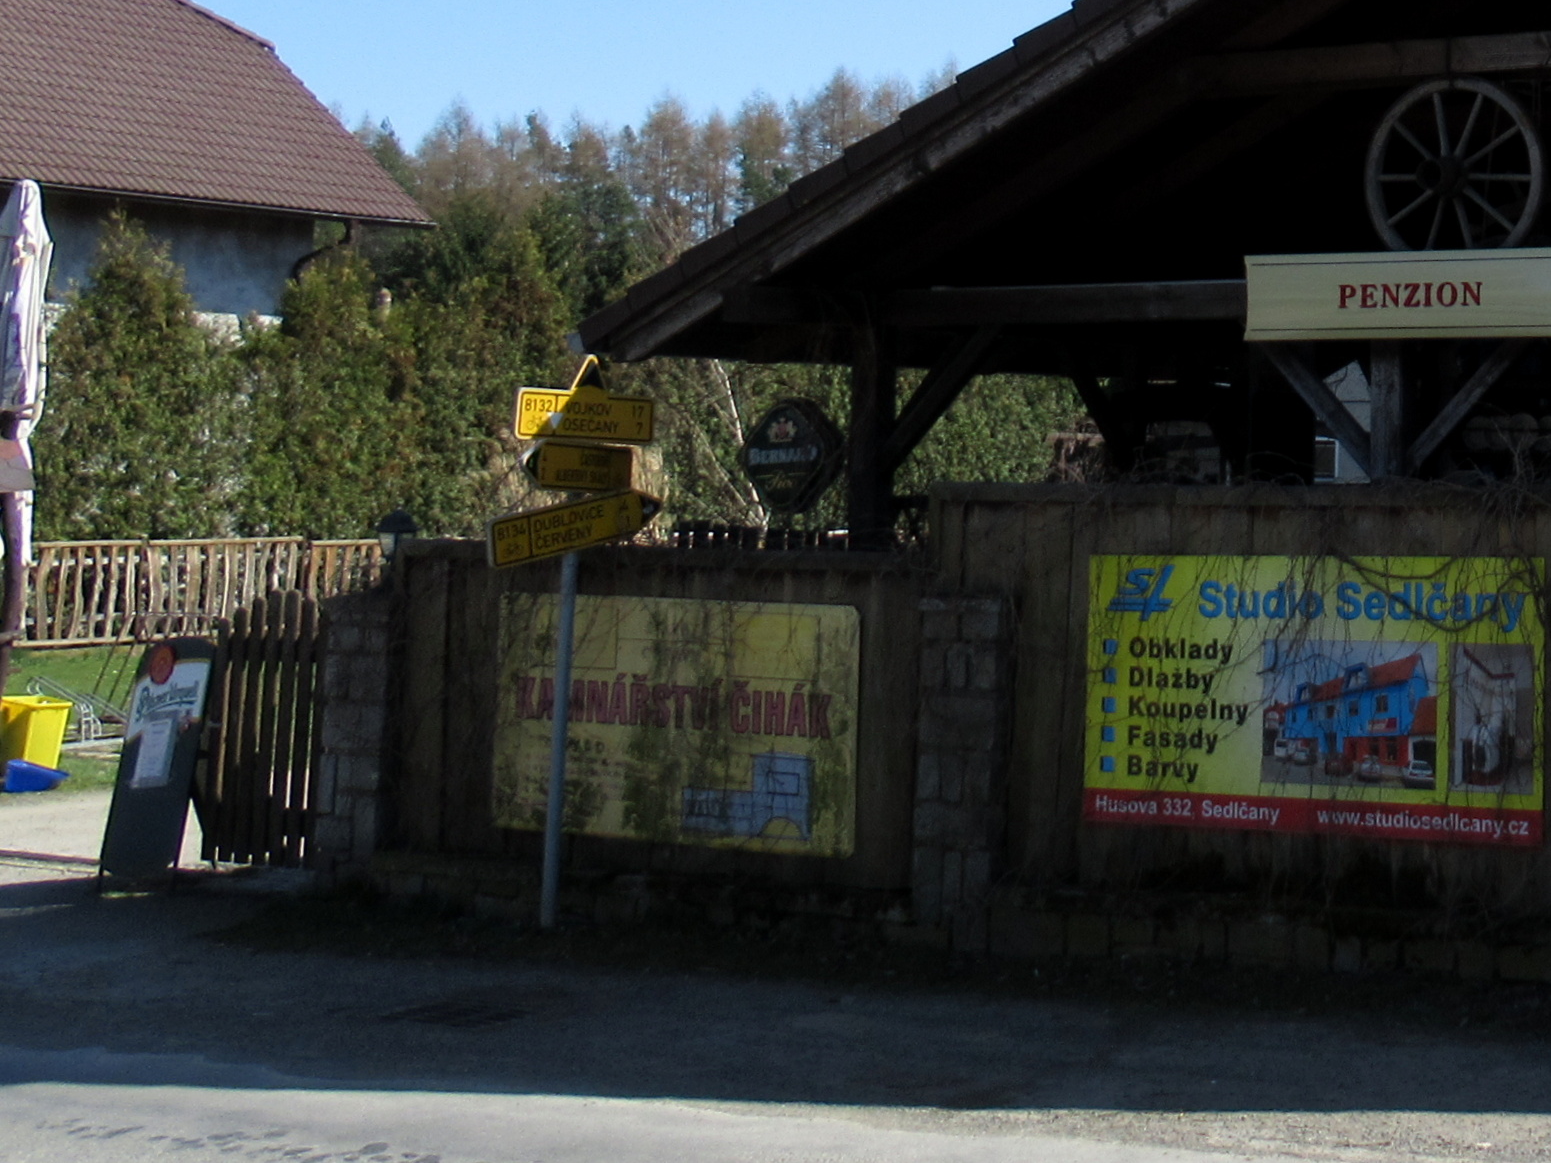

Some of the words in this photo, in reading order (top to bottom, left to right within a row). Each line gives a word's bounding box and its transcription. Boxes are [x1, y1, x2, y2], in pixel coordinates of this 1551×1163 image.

[1338, 282, 1483, 309] PENZION
[524, 397, 552, 414] 8132
[565, 400, 613, 416] VOJKOV
[631, 404, 645, 419] 17
[635, 422, 644, 436] 7
[496, 522, 526, 542] 8134
[534, 504, 604, 531] DUBLOVICE
[1199, 579, 1325, 620] Studio
[1336, 581, 1527, 633] Sedlčany
[1128, 635, 1234, 665] Obklady
[1128, 665, 1216, 694] Dlažby
[730, 679, 833, 740] ČIHÁK
[1127, 694, 1249, 725] Koupelny
[1127, 725, 1219, 753] Fasády
[1127, 754, 1200, 783] Barvy
[1094, 795, 1158, 816] Husova
[1201, 799, 1281, 824] Sedlčany
[1317, 807, 1529, 838] www.studiosedlcany.cz
